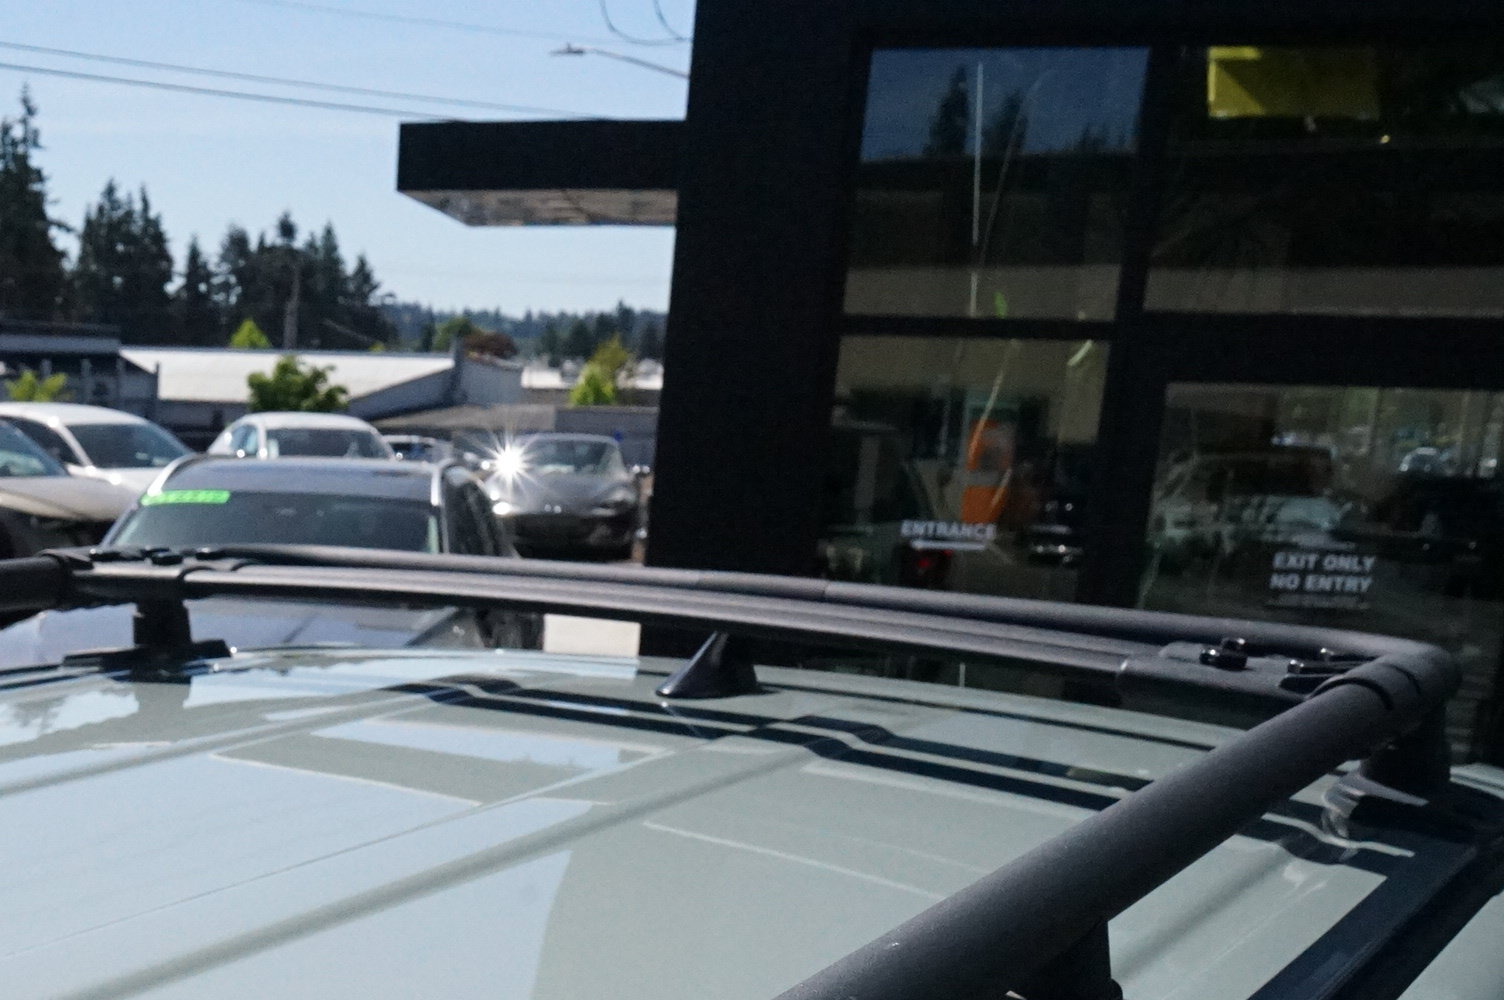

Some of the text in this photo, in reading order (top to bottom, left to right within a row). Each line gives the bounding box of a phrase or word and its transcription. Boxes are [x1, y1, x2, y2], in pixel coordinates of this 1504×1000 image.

[901, 519, 996, 540] ENTRANCE
[1273, 551, 1376, 573] EXIT ONLY
[1269, 572, 1373, 592] NO ENTRY
